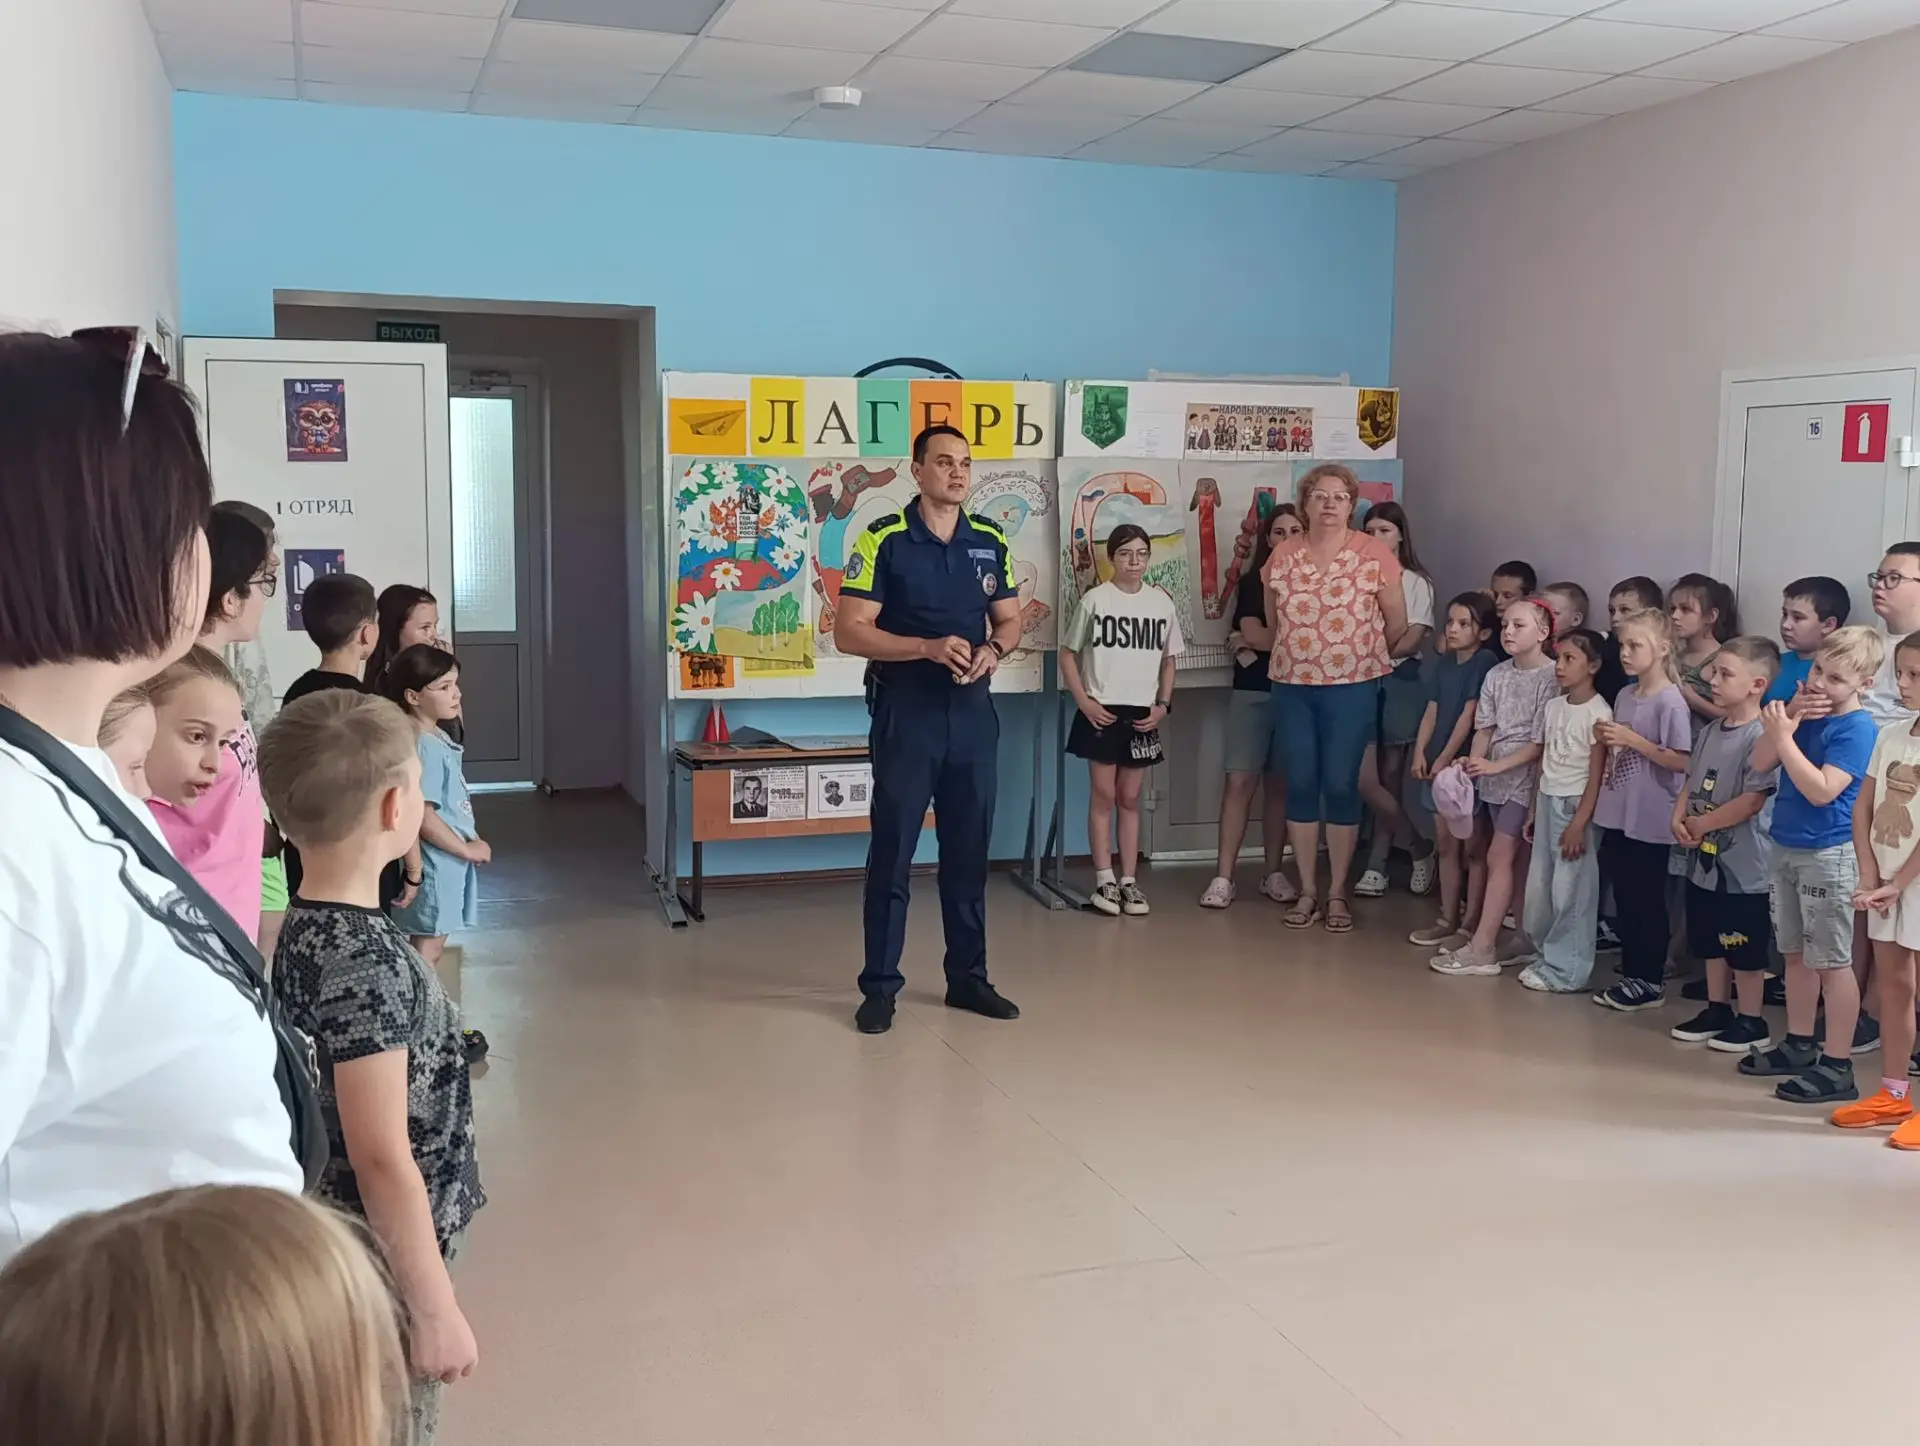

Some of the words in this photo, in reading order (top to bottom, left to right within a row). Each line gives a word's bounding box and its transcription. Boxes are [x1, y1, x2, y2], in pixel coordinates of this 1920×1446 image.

[381, 326, 436, 341] ВЫХОД
[1219, 404, 1254, 416] НАРОДЫ
[1256, 406, 1289, 416] РОССИИ
[758, 399, 1044, 446] ЛАГЕРЬ
[1809, 422, 1820, 435] 16
[289, 499, 354, 516] ОТРЯД
[1092, 614, 1167, 651] COSMIC
